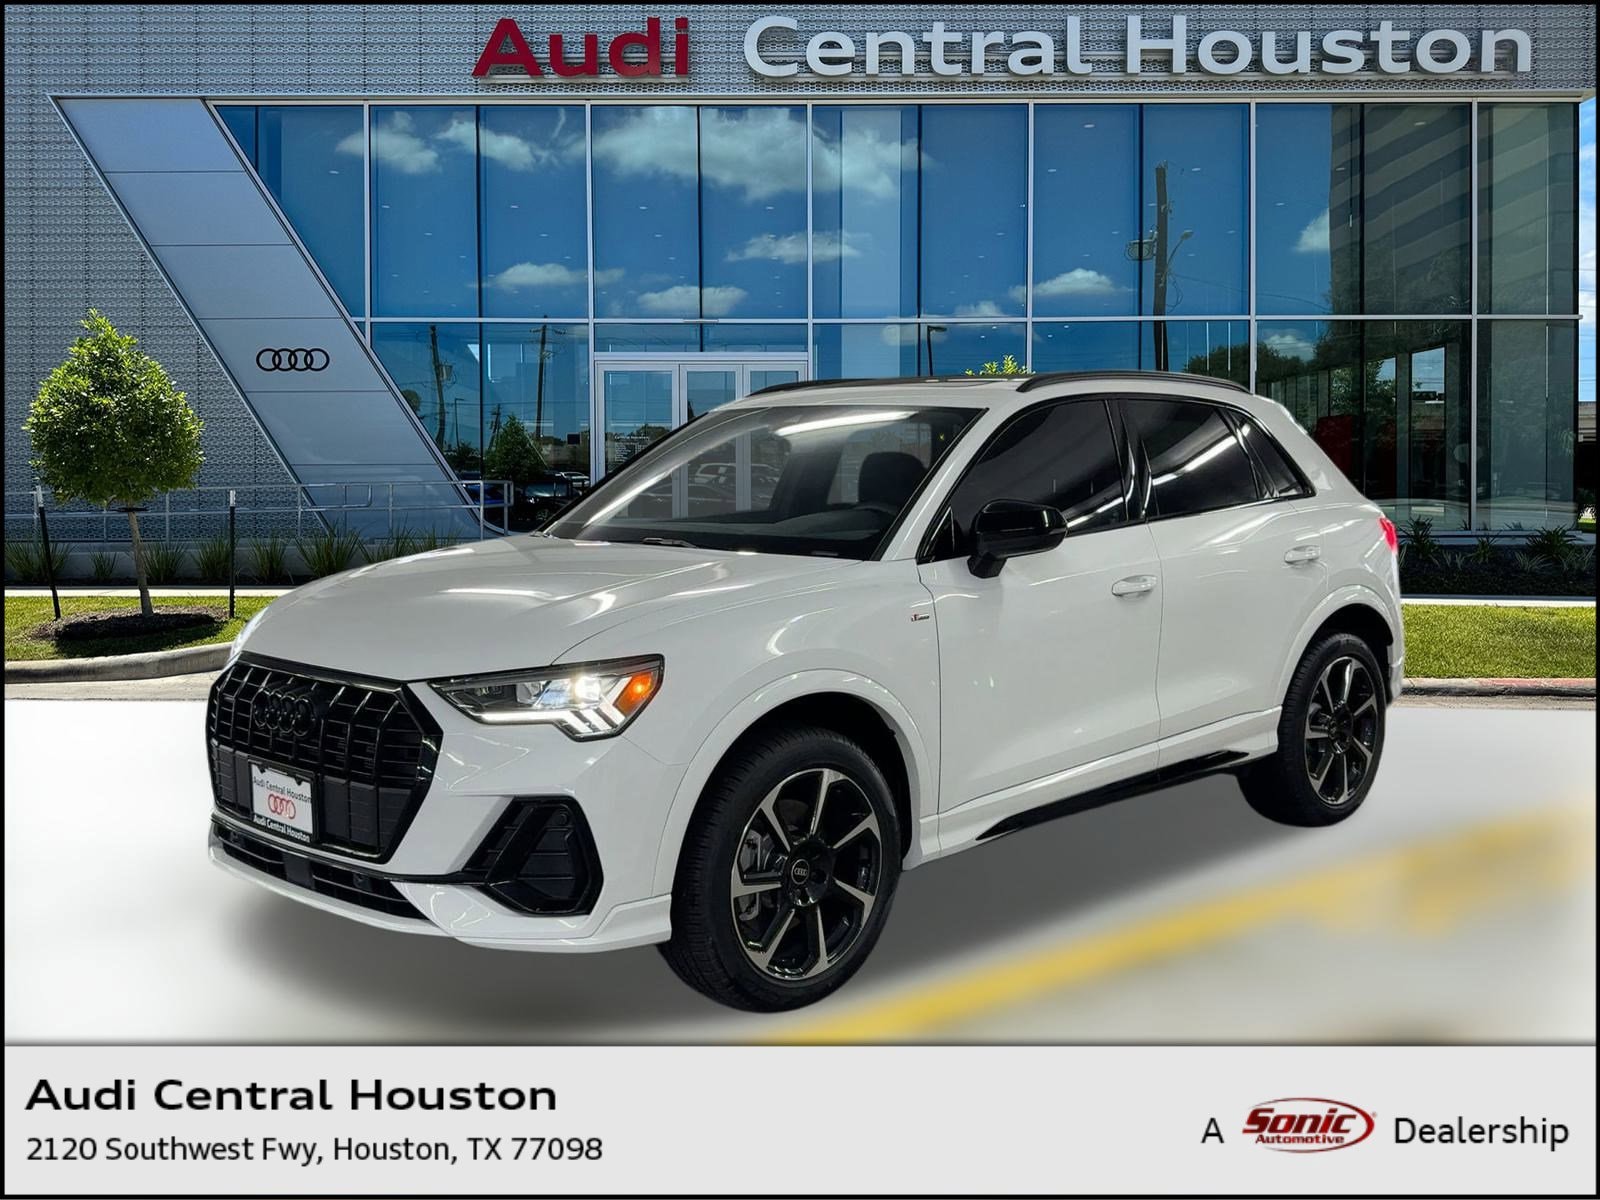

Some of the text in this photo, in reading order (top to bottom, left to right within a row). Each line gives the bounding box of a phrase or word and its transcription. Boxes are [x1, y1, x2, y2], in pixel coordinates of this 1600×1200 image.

[472, 15, 1532, 77] Audi Central Houston
[266, 780, 286, 794] Central
[287, 788, 312, 803] Houston
[253, 814, 310, 842] Audi Central Houston
